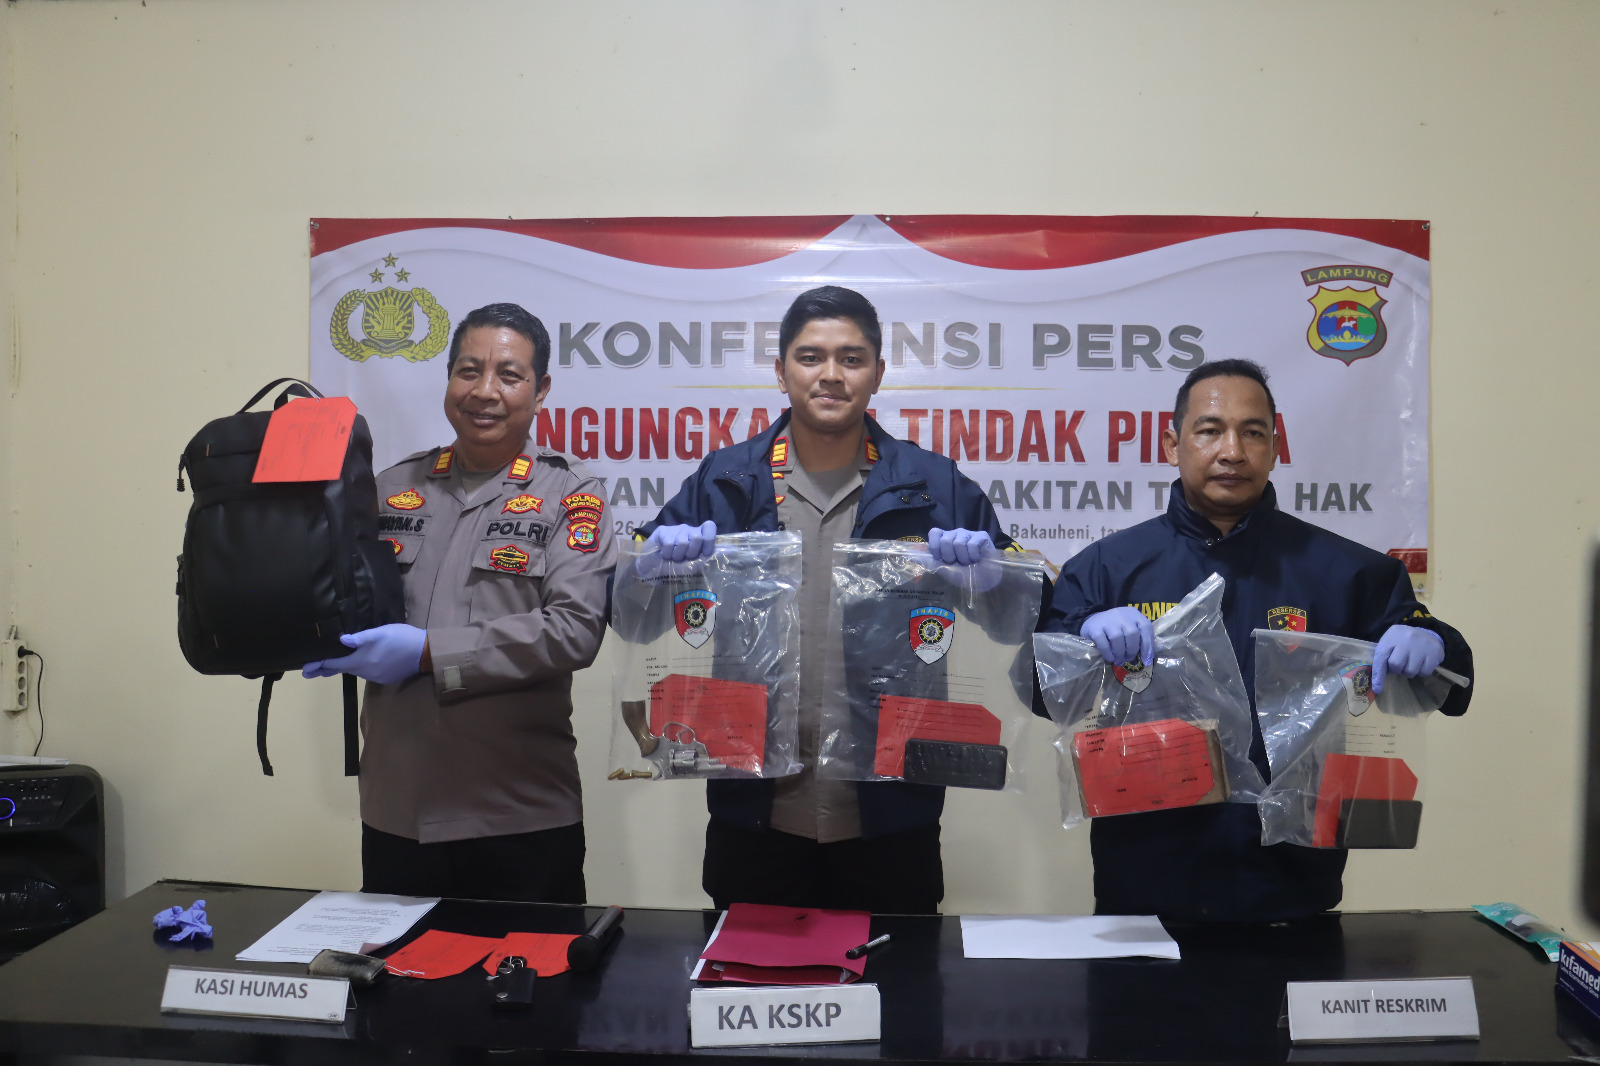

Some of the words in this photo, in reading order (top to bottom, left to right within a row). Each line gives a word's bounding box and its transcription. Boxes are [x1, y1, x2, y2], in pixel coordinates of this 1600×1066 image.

[1307, 268, 1389, 283] LAMPUNG
[558, 321, 1001, 369] KONFENSI
[1032, 323, 1206, 371] PERS
[900, 408, 1086, 463] TINDAK
[975, 480, 1133, 511] AKITAN
[1294, 482, 1373, 512] HAK
[486, 521, 549, 541] POLRI
[1009, 523, 1095, 541] Bakauheni,
[916, 608, 949, 617] INAFIS
[195, 978, 235, 995] KASI
[239, 980, 309, 999] HUMAS
[718, 1005, 759, 1030] KA
[768, 1002, 842, 1029] KSKP
[1321, 999, 1371, 1014] KANIT
[1375, 998, 1447, 1014] RESKRIM
